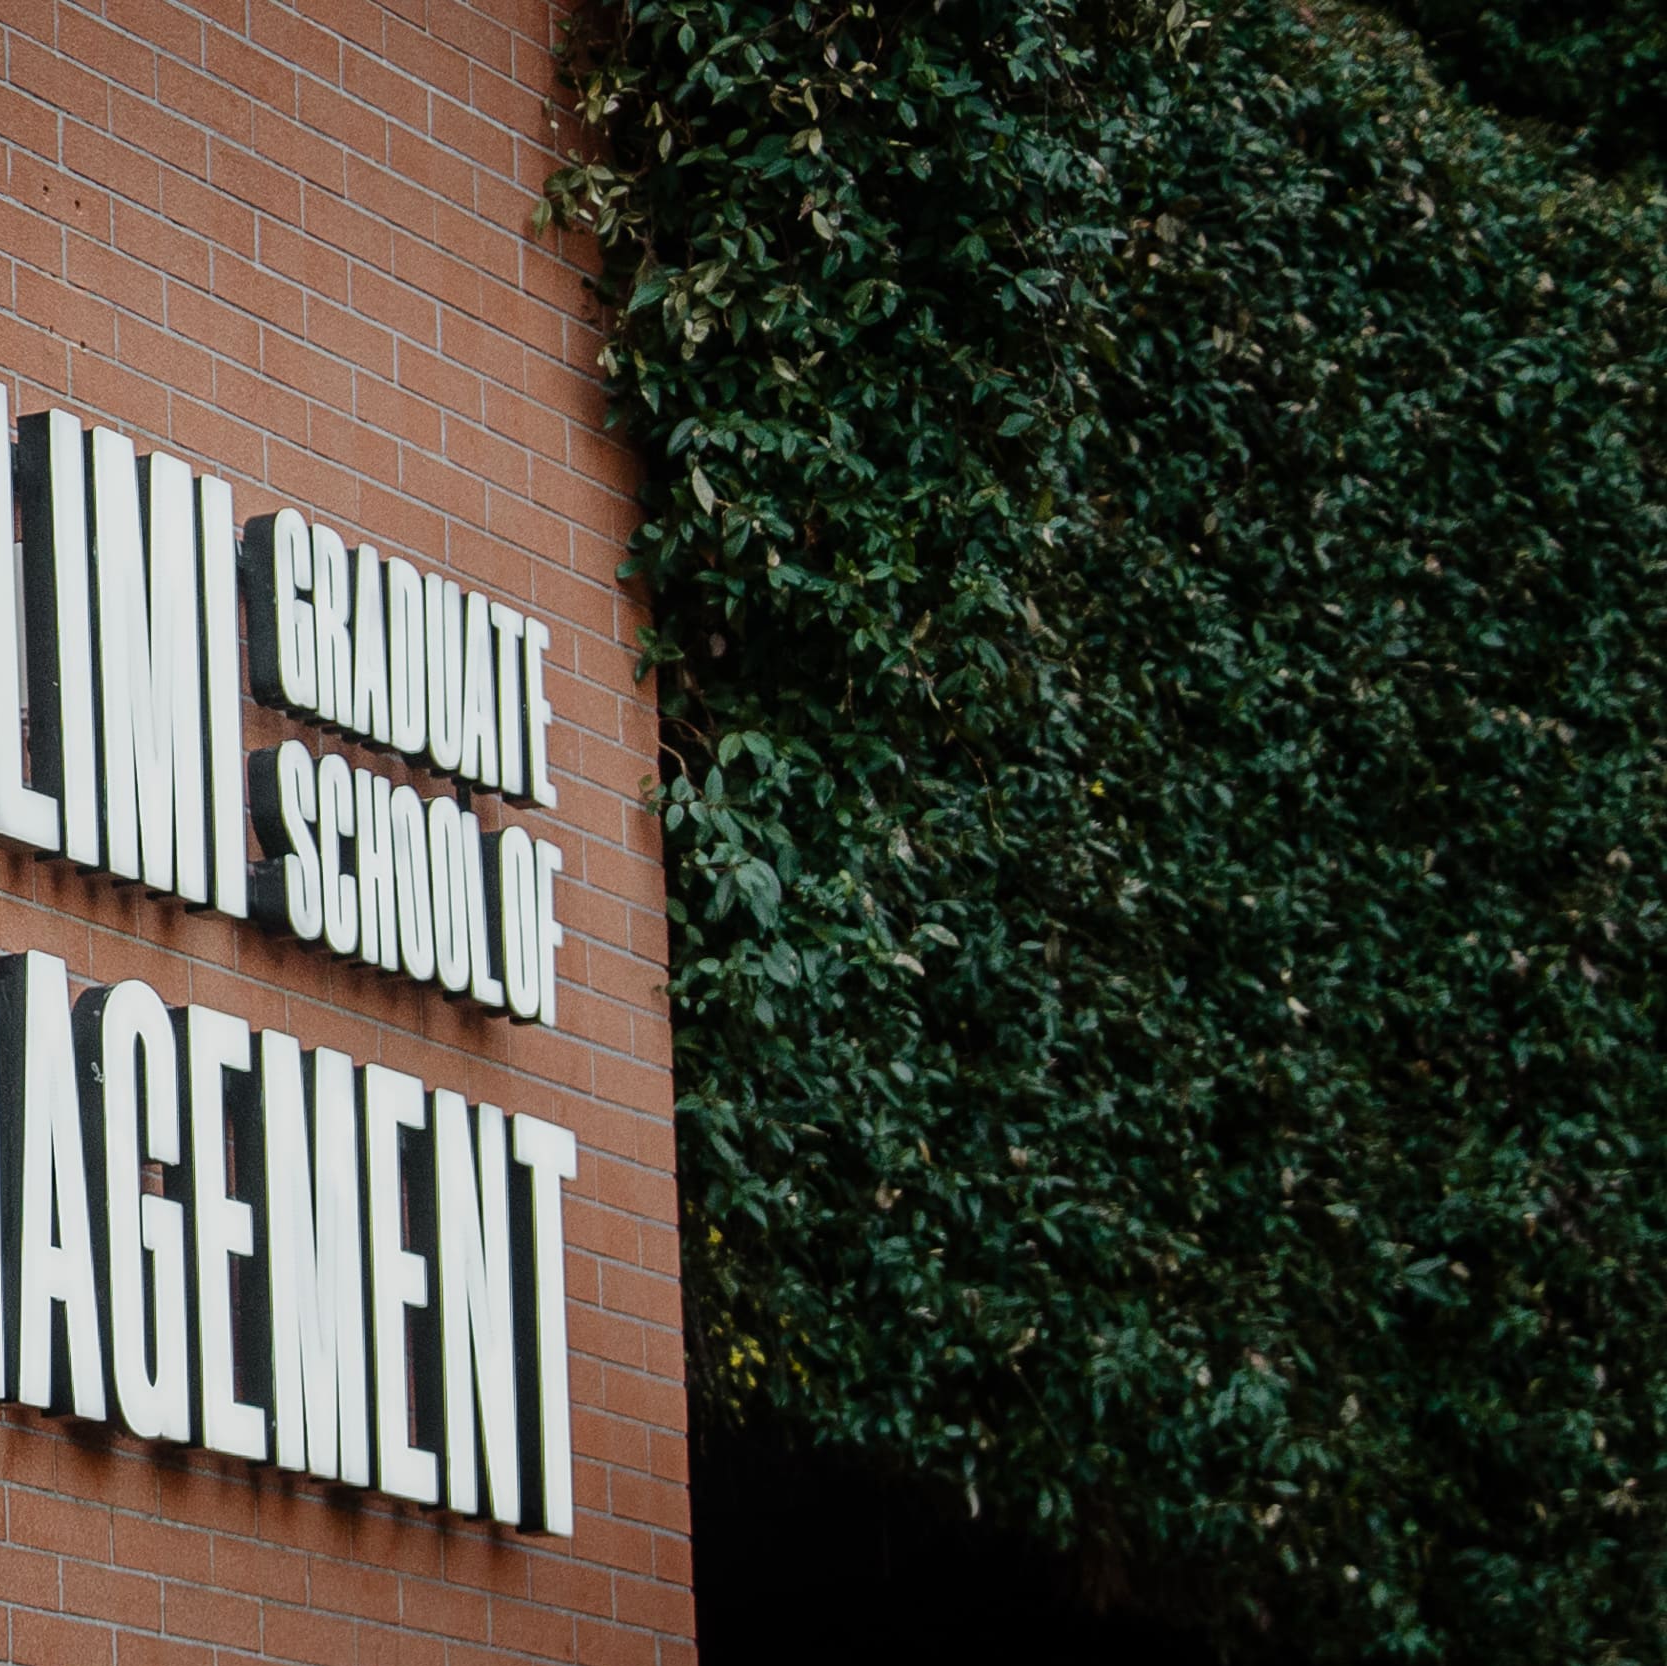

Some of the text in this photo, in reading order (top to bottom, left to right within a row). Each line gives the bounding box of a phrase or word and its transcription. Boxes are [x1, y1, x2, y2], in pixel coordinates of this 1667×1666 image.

[273, 507, 557, 809] GRADUATE
[277, 739, 563, 1027] SCHOOL OF
